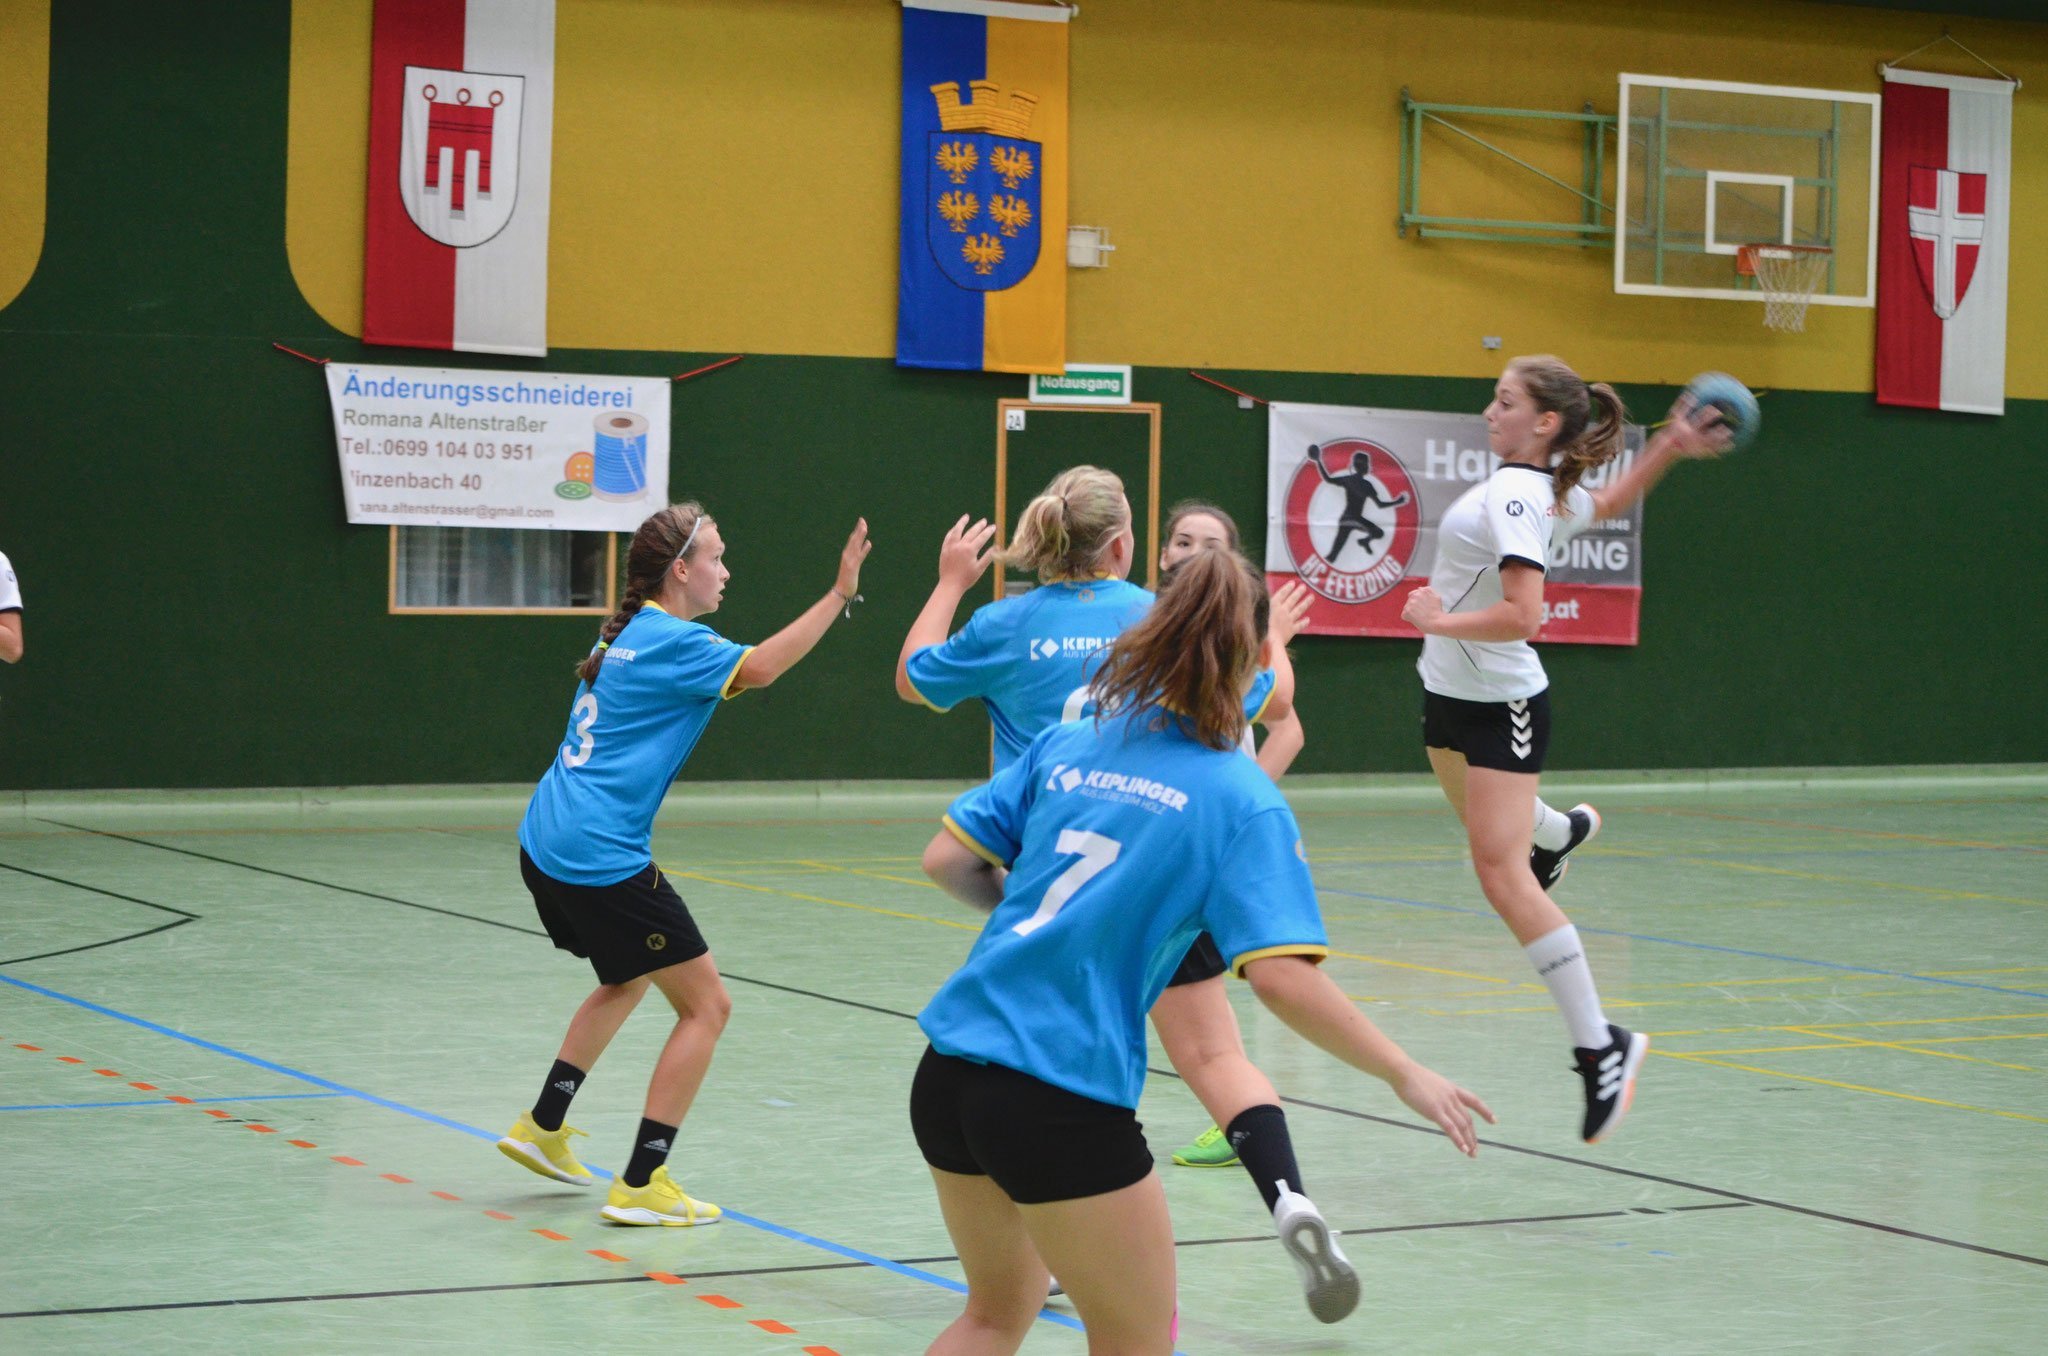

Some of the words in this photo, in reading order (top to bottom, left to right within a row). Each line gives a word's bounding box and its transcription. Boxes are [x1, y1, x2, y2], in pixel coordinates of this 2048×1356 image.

[343, 369, 633, 408] Änderungsschneiderei
[1041, 375, 1121, 393] Notausgang
[343, 408, 423, 429] Romana
[428, 411, 549, 433] Altenstraßer
[435, 441, 468, 459] 104
[473, 442, 496, 460] 03
[501, 443, 534, 461] 951
[459, 474, 483, 491] 40
[1550, 538, 1630, 572] DING
[1324, 554, 1403, 600] EFERDING
[604, 647, 637, 662] LINGER
[1062, 636, 1118, 651] KEPLI
[561, 692, 599, 769] 3
[1084, 770, 1190, 813] KEPLINGER
[1011, 828, 1122, 937] 7
